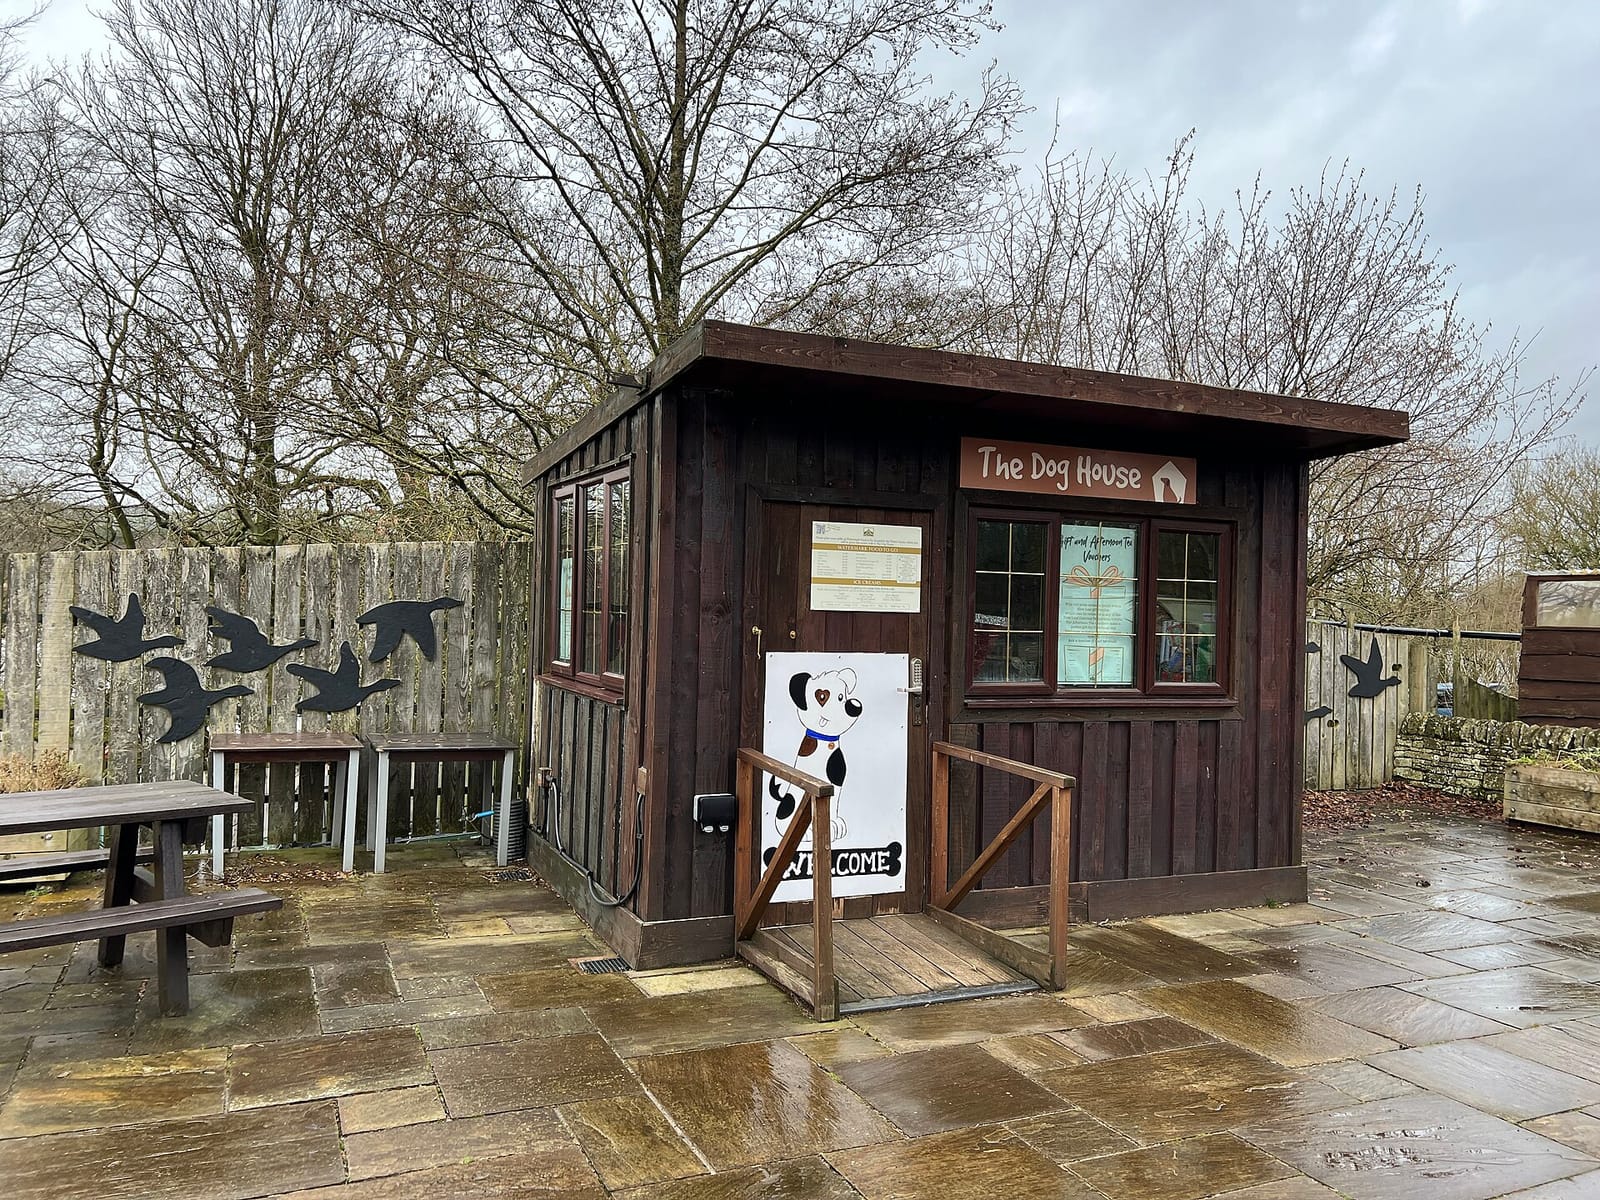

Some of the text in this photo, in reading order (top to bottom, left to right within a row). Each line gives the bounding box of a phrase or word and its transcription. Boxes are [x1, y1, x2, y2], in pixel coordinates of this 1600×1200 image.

[978, 446, 1142, 491] The Dog House
[1074, 535, 1088, 548] and
[1123, 536, 1133, 549] Tea
[782, 850, 890, 879] WECOME
